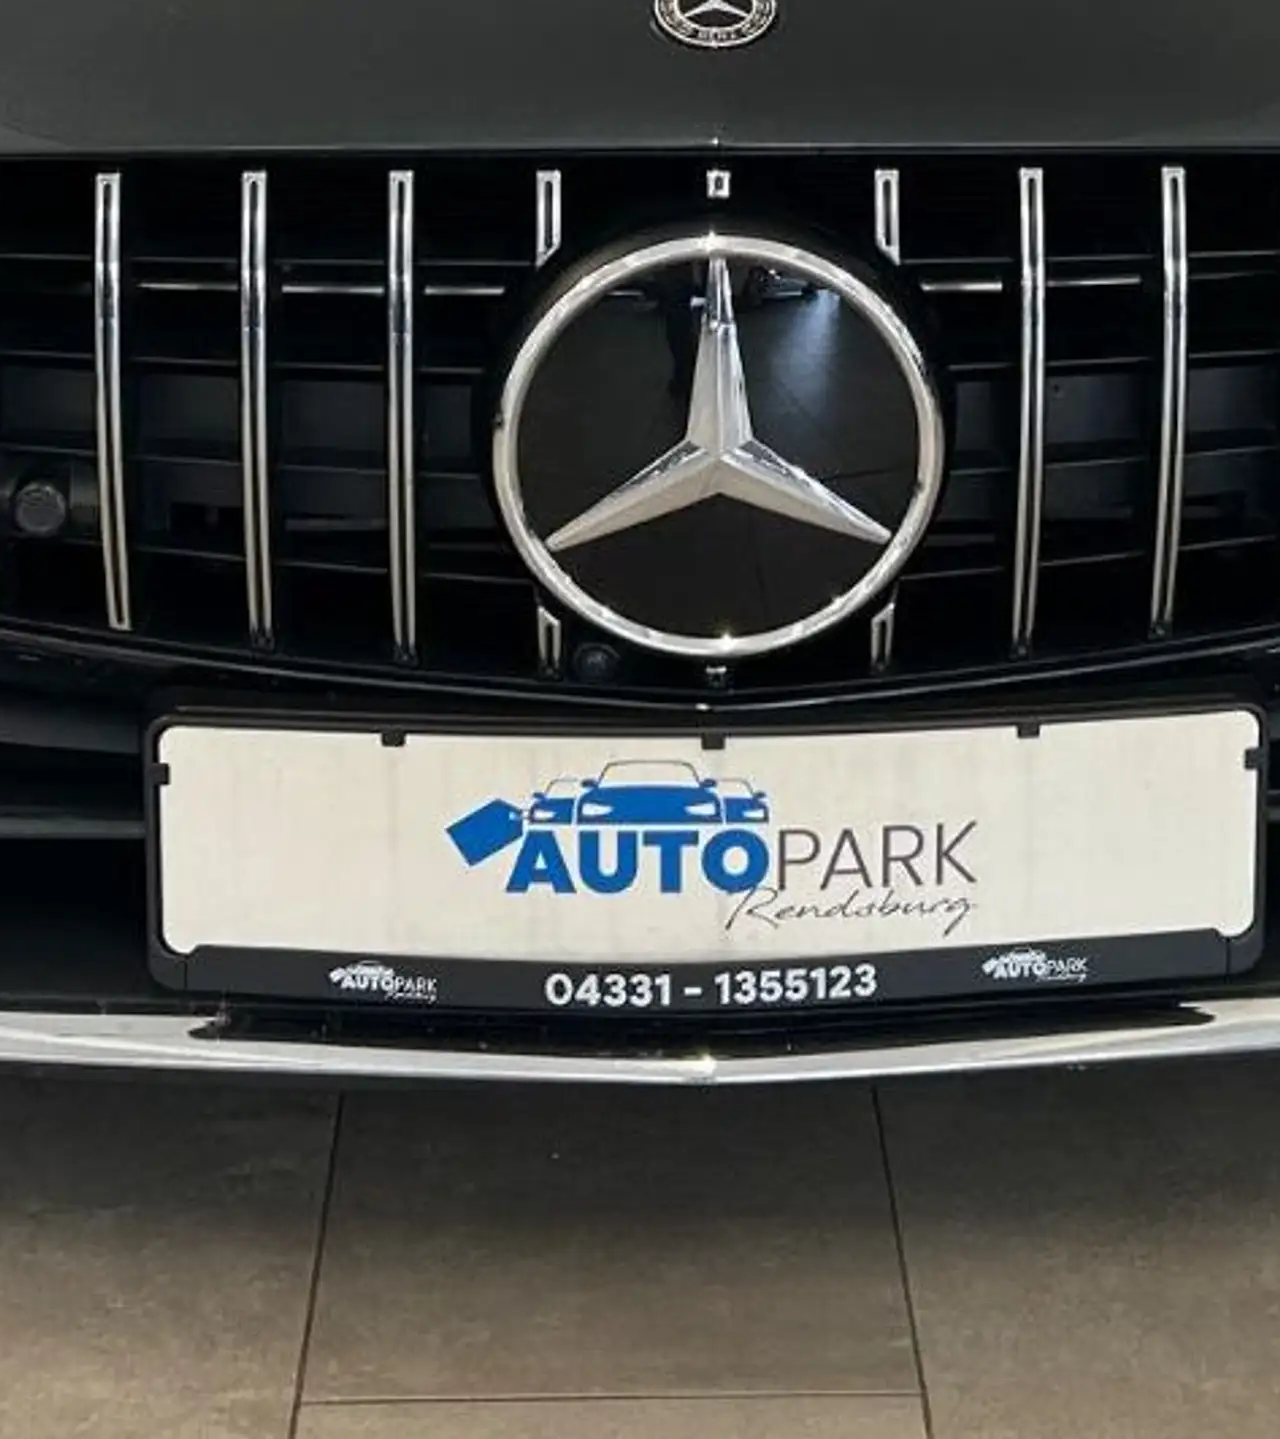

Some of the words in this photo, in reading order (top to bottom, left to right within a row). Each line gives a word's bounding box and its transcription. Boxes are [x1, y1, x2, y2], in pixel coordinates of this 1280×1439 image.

[505, 819, 977, 894] AUTOPARK
[725, 885, 976, 937] Rendsburg
[340, 974, 437, 993] AUTOPARK
[543, 972, 671, 1007] 04331
[683, 985, 703, 997] -
[714, 963, 878, 1005] 1355123
[992, 957, 1088, 979] AUTOPARK
